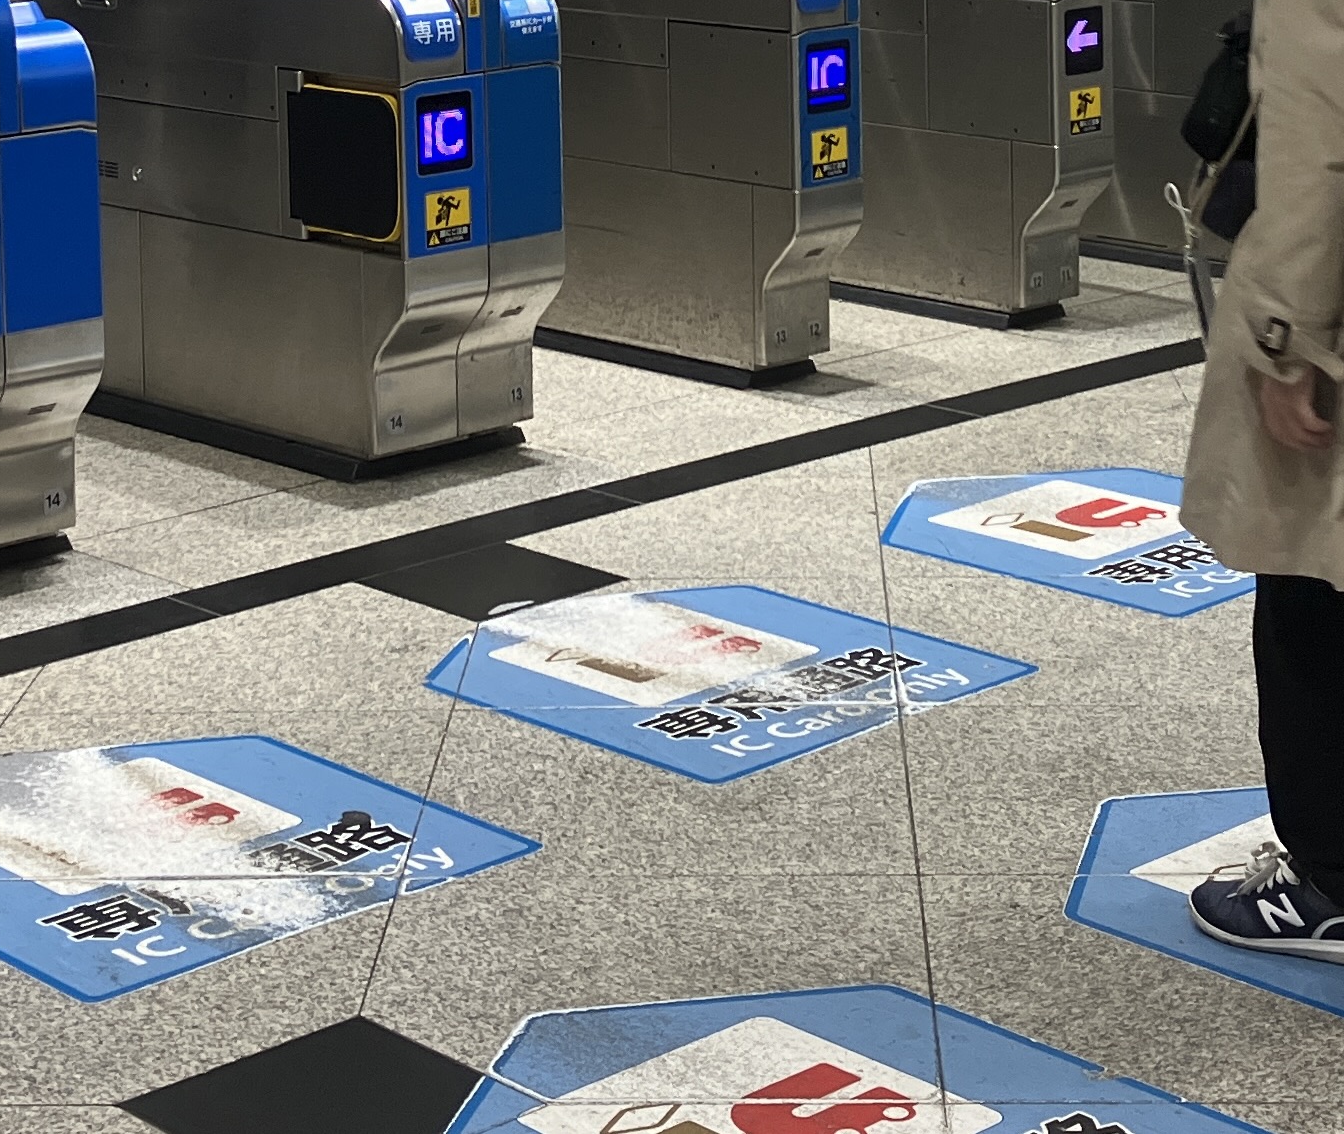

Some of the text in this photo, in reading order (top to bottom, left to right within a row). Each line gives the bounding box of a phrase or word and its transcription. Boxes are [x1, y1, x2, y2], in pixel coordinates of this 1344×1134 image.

[412, 18, 455, 45] 専用
[423, 109, 464, 159] IC
[1032, 275, 1044, 289] 12
[775, 329, 787, 345] 13
[809, 322, 821, 337] 12
[511, 387, 523, 403] 13
[390, 415, 403, 430] 14
[45, 492, 61, 509] 14
[1083, 534, 1220, 586] 専用
[1158, 580, 1215, 599] IC
[710, 734, 775, 758] IC
[35, 809, 416, 943] 専路
[1256, 892, 1306, 934] N
[110, 934, 188, 967] IC
